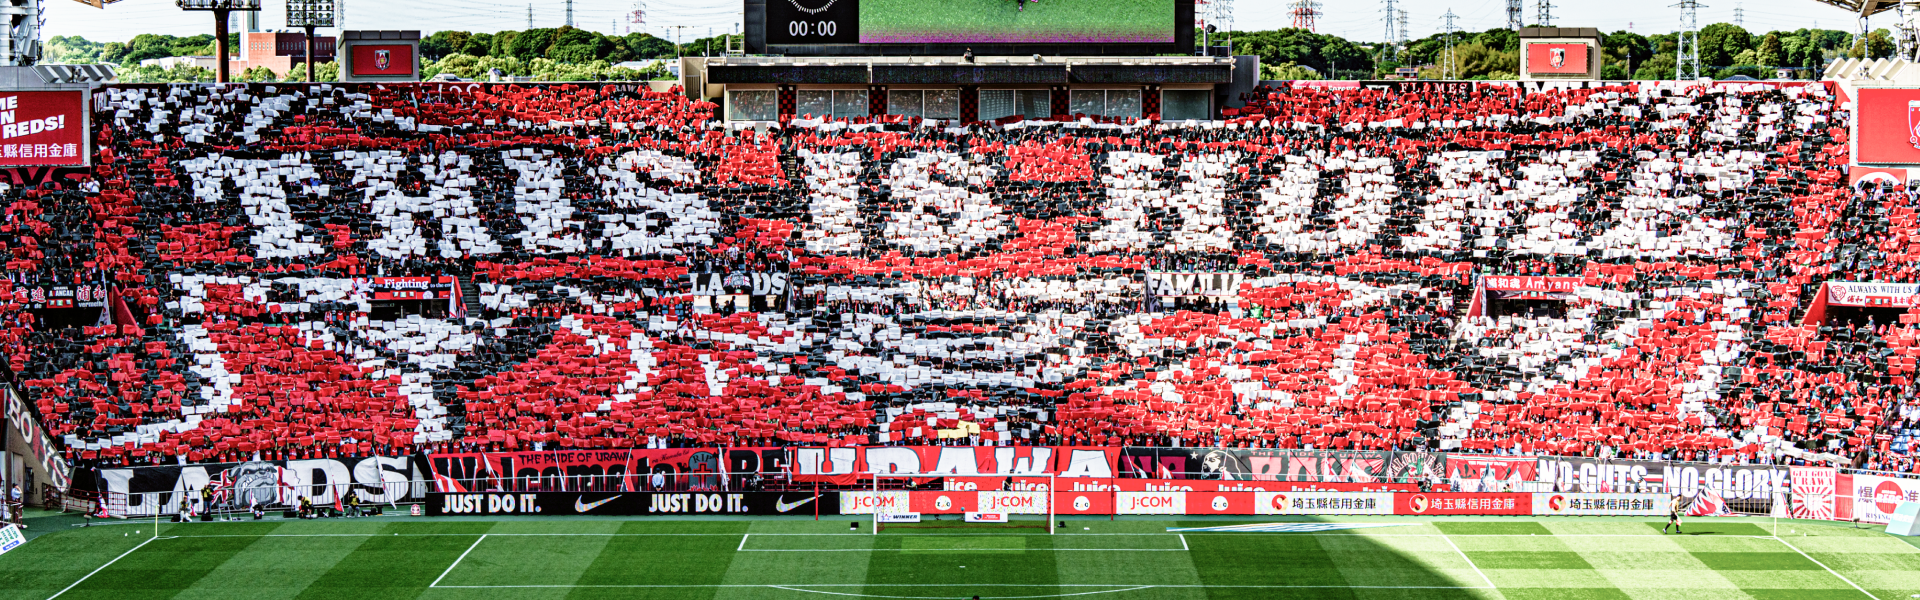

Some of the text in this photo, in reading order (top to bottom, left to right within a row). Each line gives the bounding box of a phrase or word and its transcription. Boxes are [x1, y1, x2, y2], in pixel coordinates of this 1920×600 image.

[789, 20, 837, 37] 00:00
[2, 114, 65, 139] REDS!
[0, 143, 78, 158] 縣信用金庫
[181, 150, 721, 260] THIS
[797, 149, 1007, 258] IS
[384, 278, 428, 290] Fighting
[1848, 285, 1877, 293] ALWAYS
[1880, 285, 1900, 293] WITH
[518, 451, 634, 465] THE PRIDE OF URAWA
[693, 454, 713, 463] RIP
[797, 447, 1113, 478] URAWA
[1538, 459, 1573, 492] NO
[1663, 466, 1699, 498] NO
[1705, 467, 1788, 500] GLORY
[1793, 477, 1833, 485] URAWA
[441, 494, 542, 513] JUST DO IT.
[649, 493, 749, 512] JUST DO IT.
[853, 496, 895, 510] J:COM
[990, 496, 1033, 510] J:COM
[1130, 496, 1173, 510] J:COM
